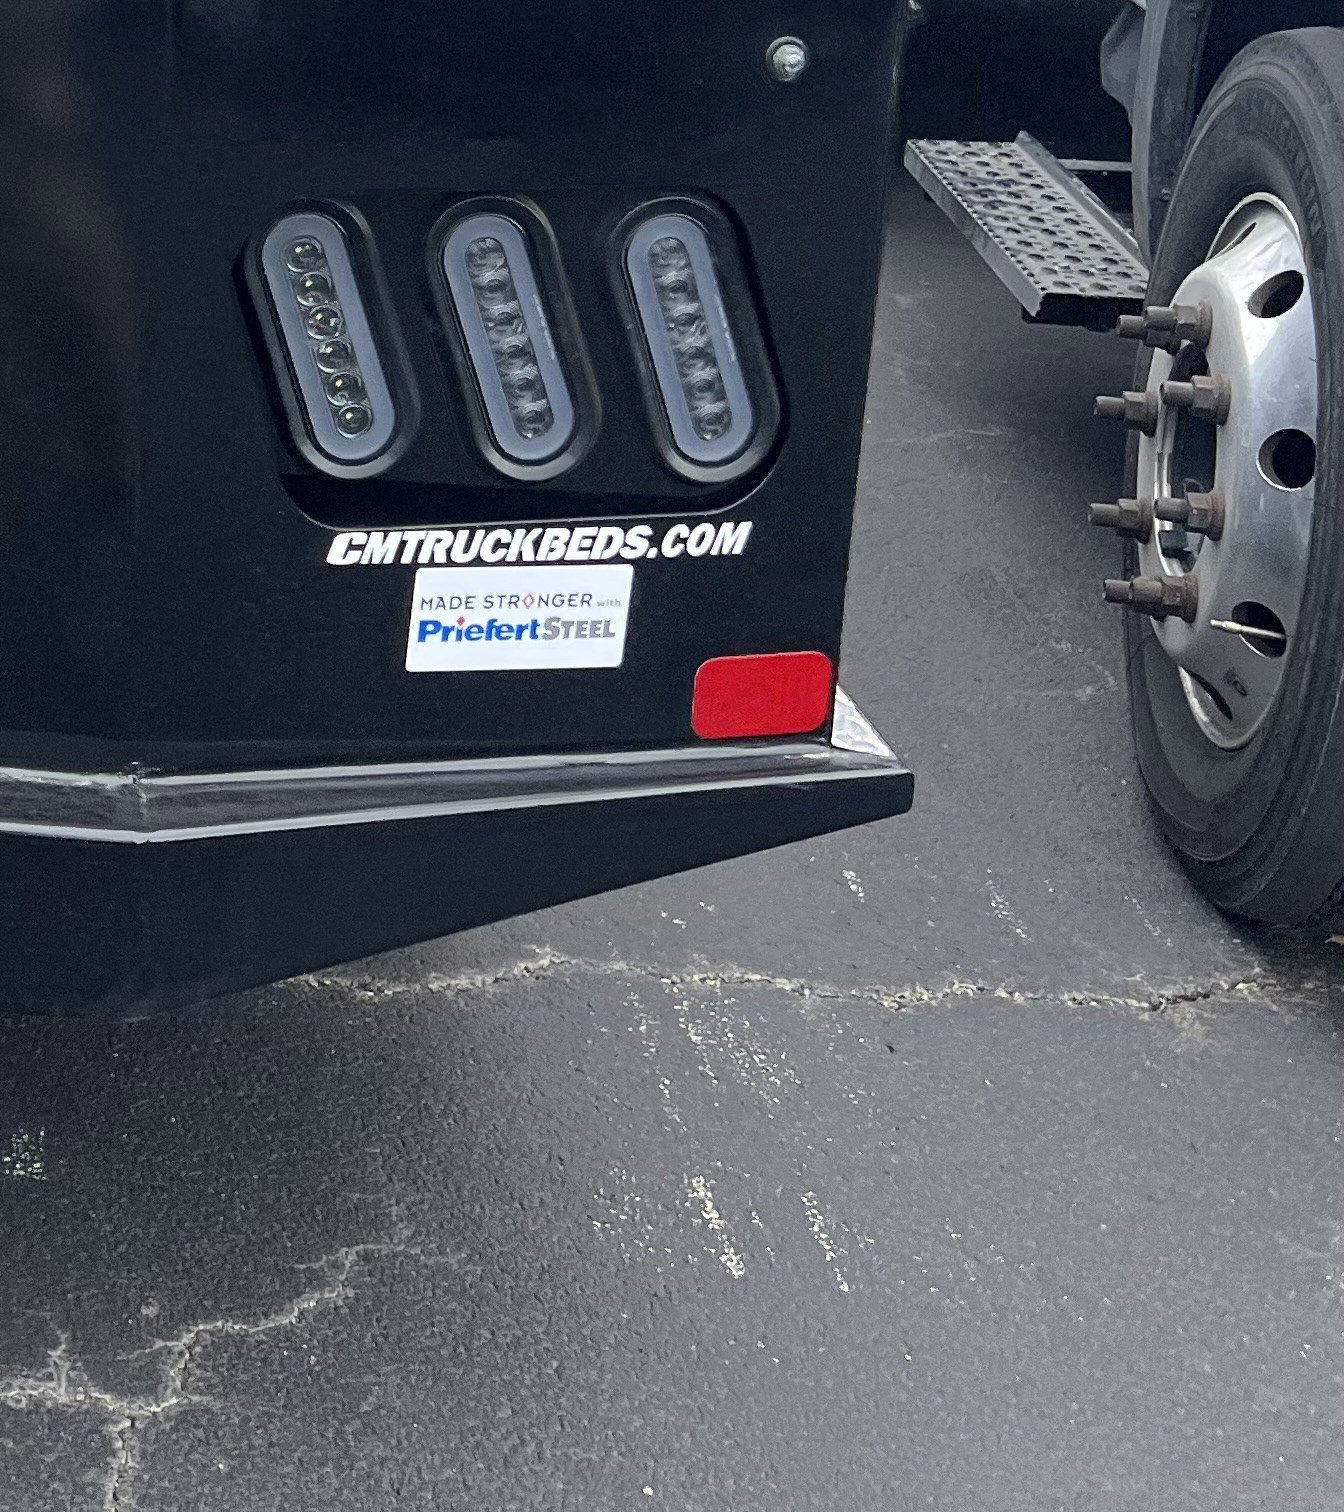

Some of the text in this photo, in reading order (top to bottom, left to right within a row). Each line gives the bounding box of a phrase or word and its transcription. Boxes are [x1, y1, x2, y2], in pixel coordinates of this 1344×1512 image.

[326, 521, 753, 566] CMTRUCKBEDS.COM
[420, 592, 621, 612] MADE STRONGER with
